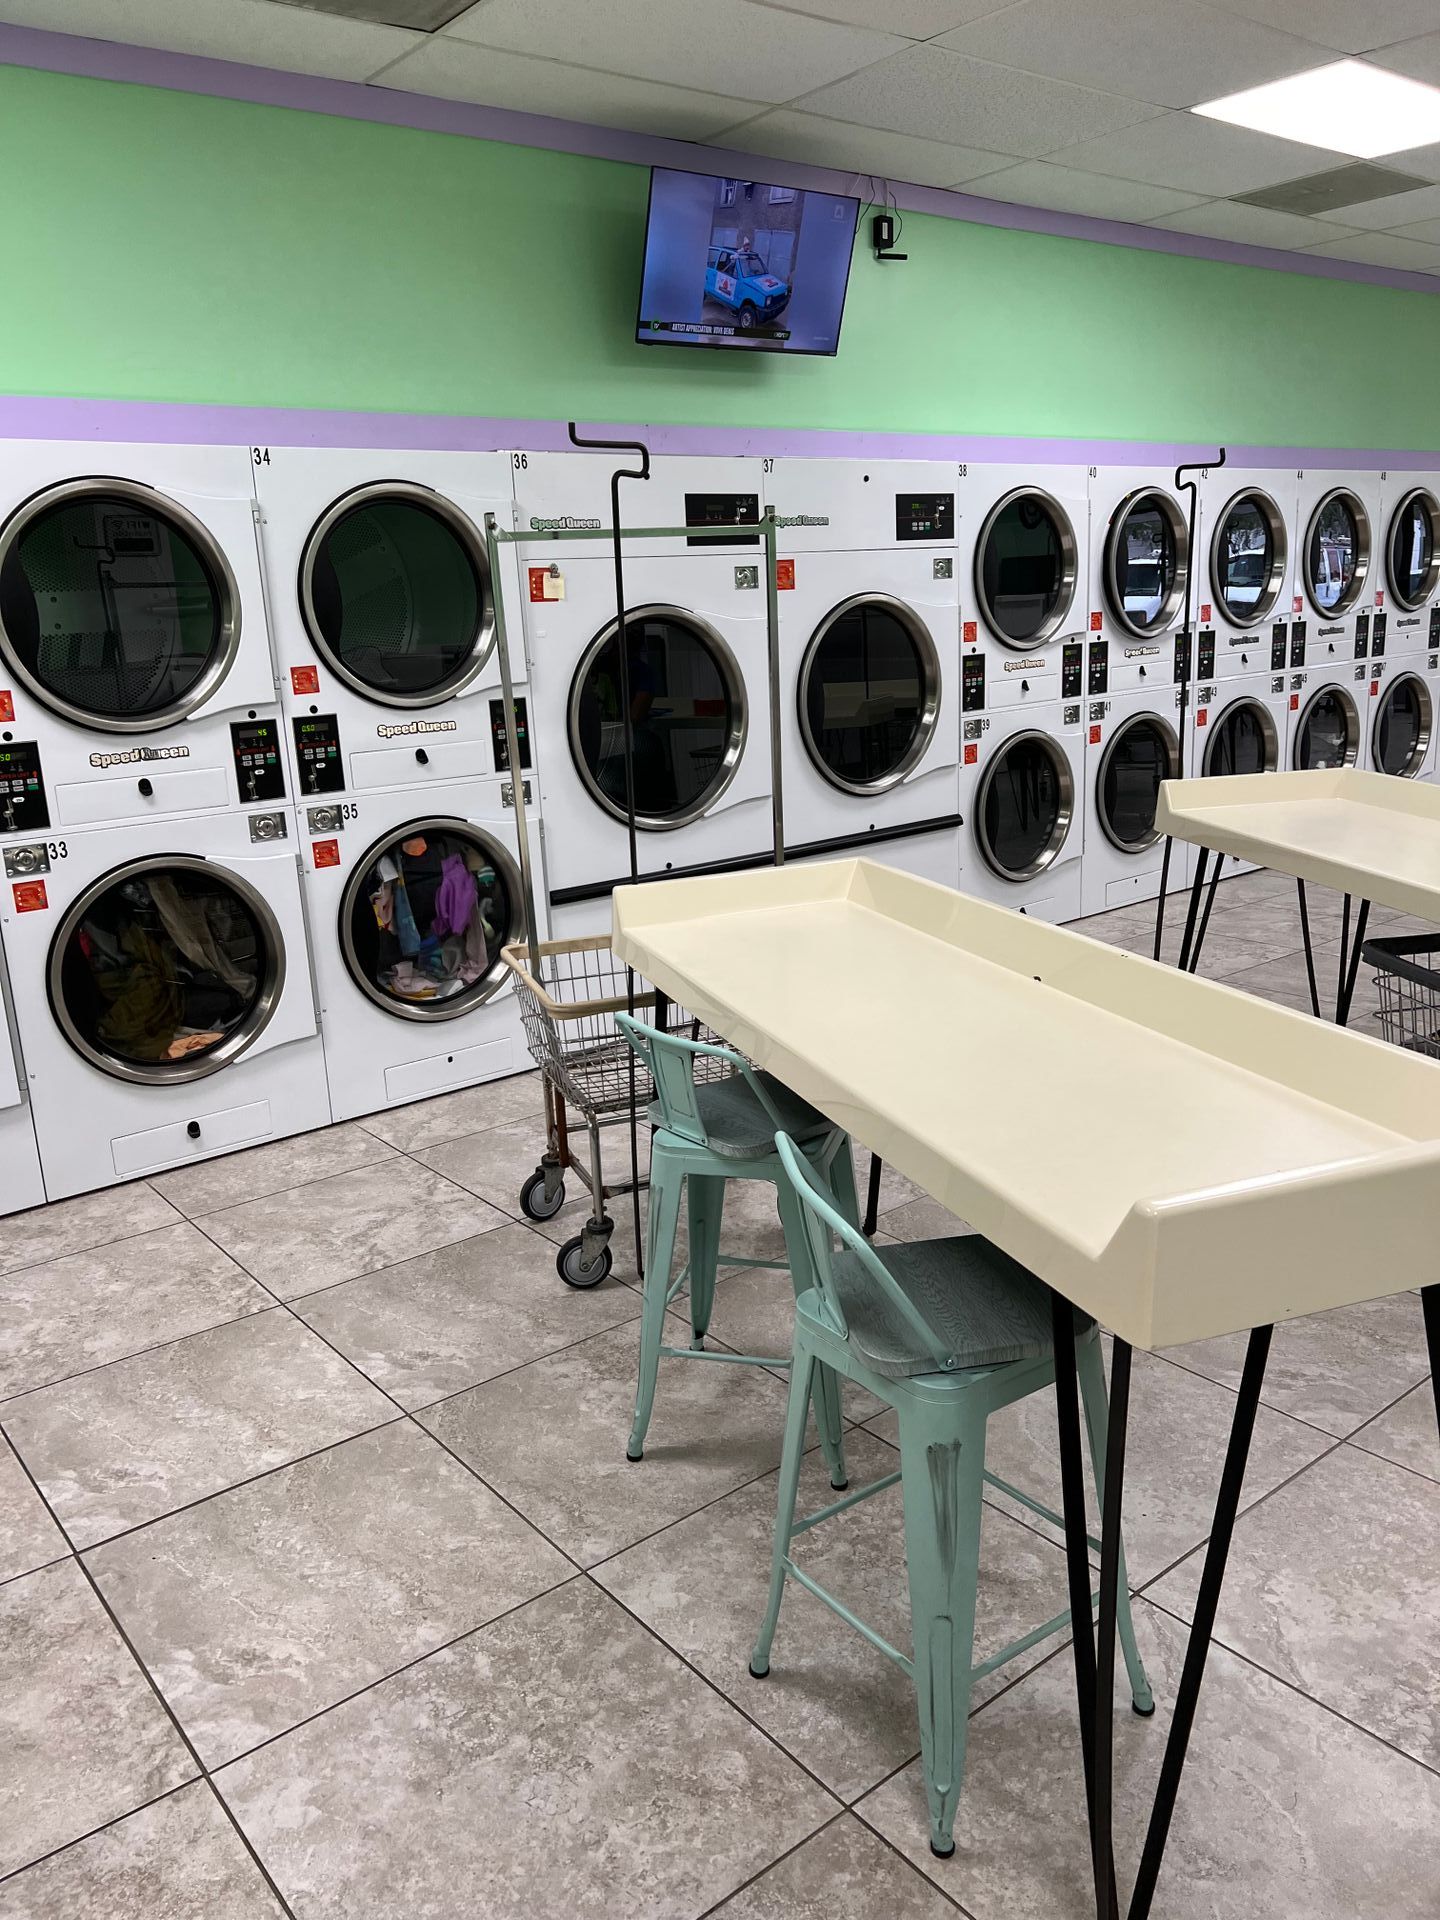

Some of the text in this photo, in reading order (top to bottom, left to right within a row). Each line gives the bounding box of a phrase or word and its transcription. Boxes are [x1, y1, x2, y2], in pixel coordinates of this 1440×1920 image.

[253, 447, 271, 466] 34
[513, 453, 528, 470] 36
[763, 458, 774, 473] 37
[958, 464, 967, 477] 38
[1088, 466, 1097, 479] 40
[1201, 468, 1209, 480] 42
[530, 516, 601, 531] Speed Queen
[774, 515, 829, 528] Speed Queen
[1004, 659, 1045, 672] Speed Queen
[1104, 701, 1111, 712] 41
[377, 720, 456, 739] Speed Queen
[981, 718, 990, 730] 39
[89, 746, 189, 768] Speed Queen
[342, 803, 358, 820] 35
[48, 841, 68, 860] 33
